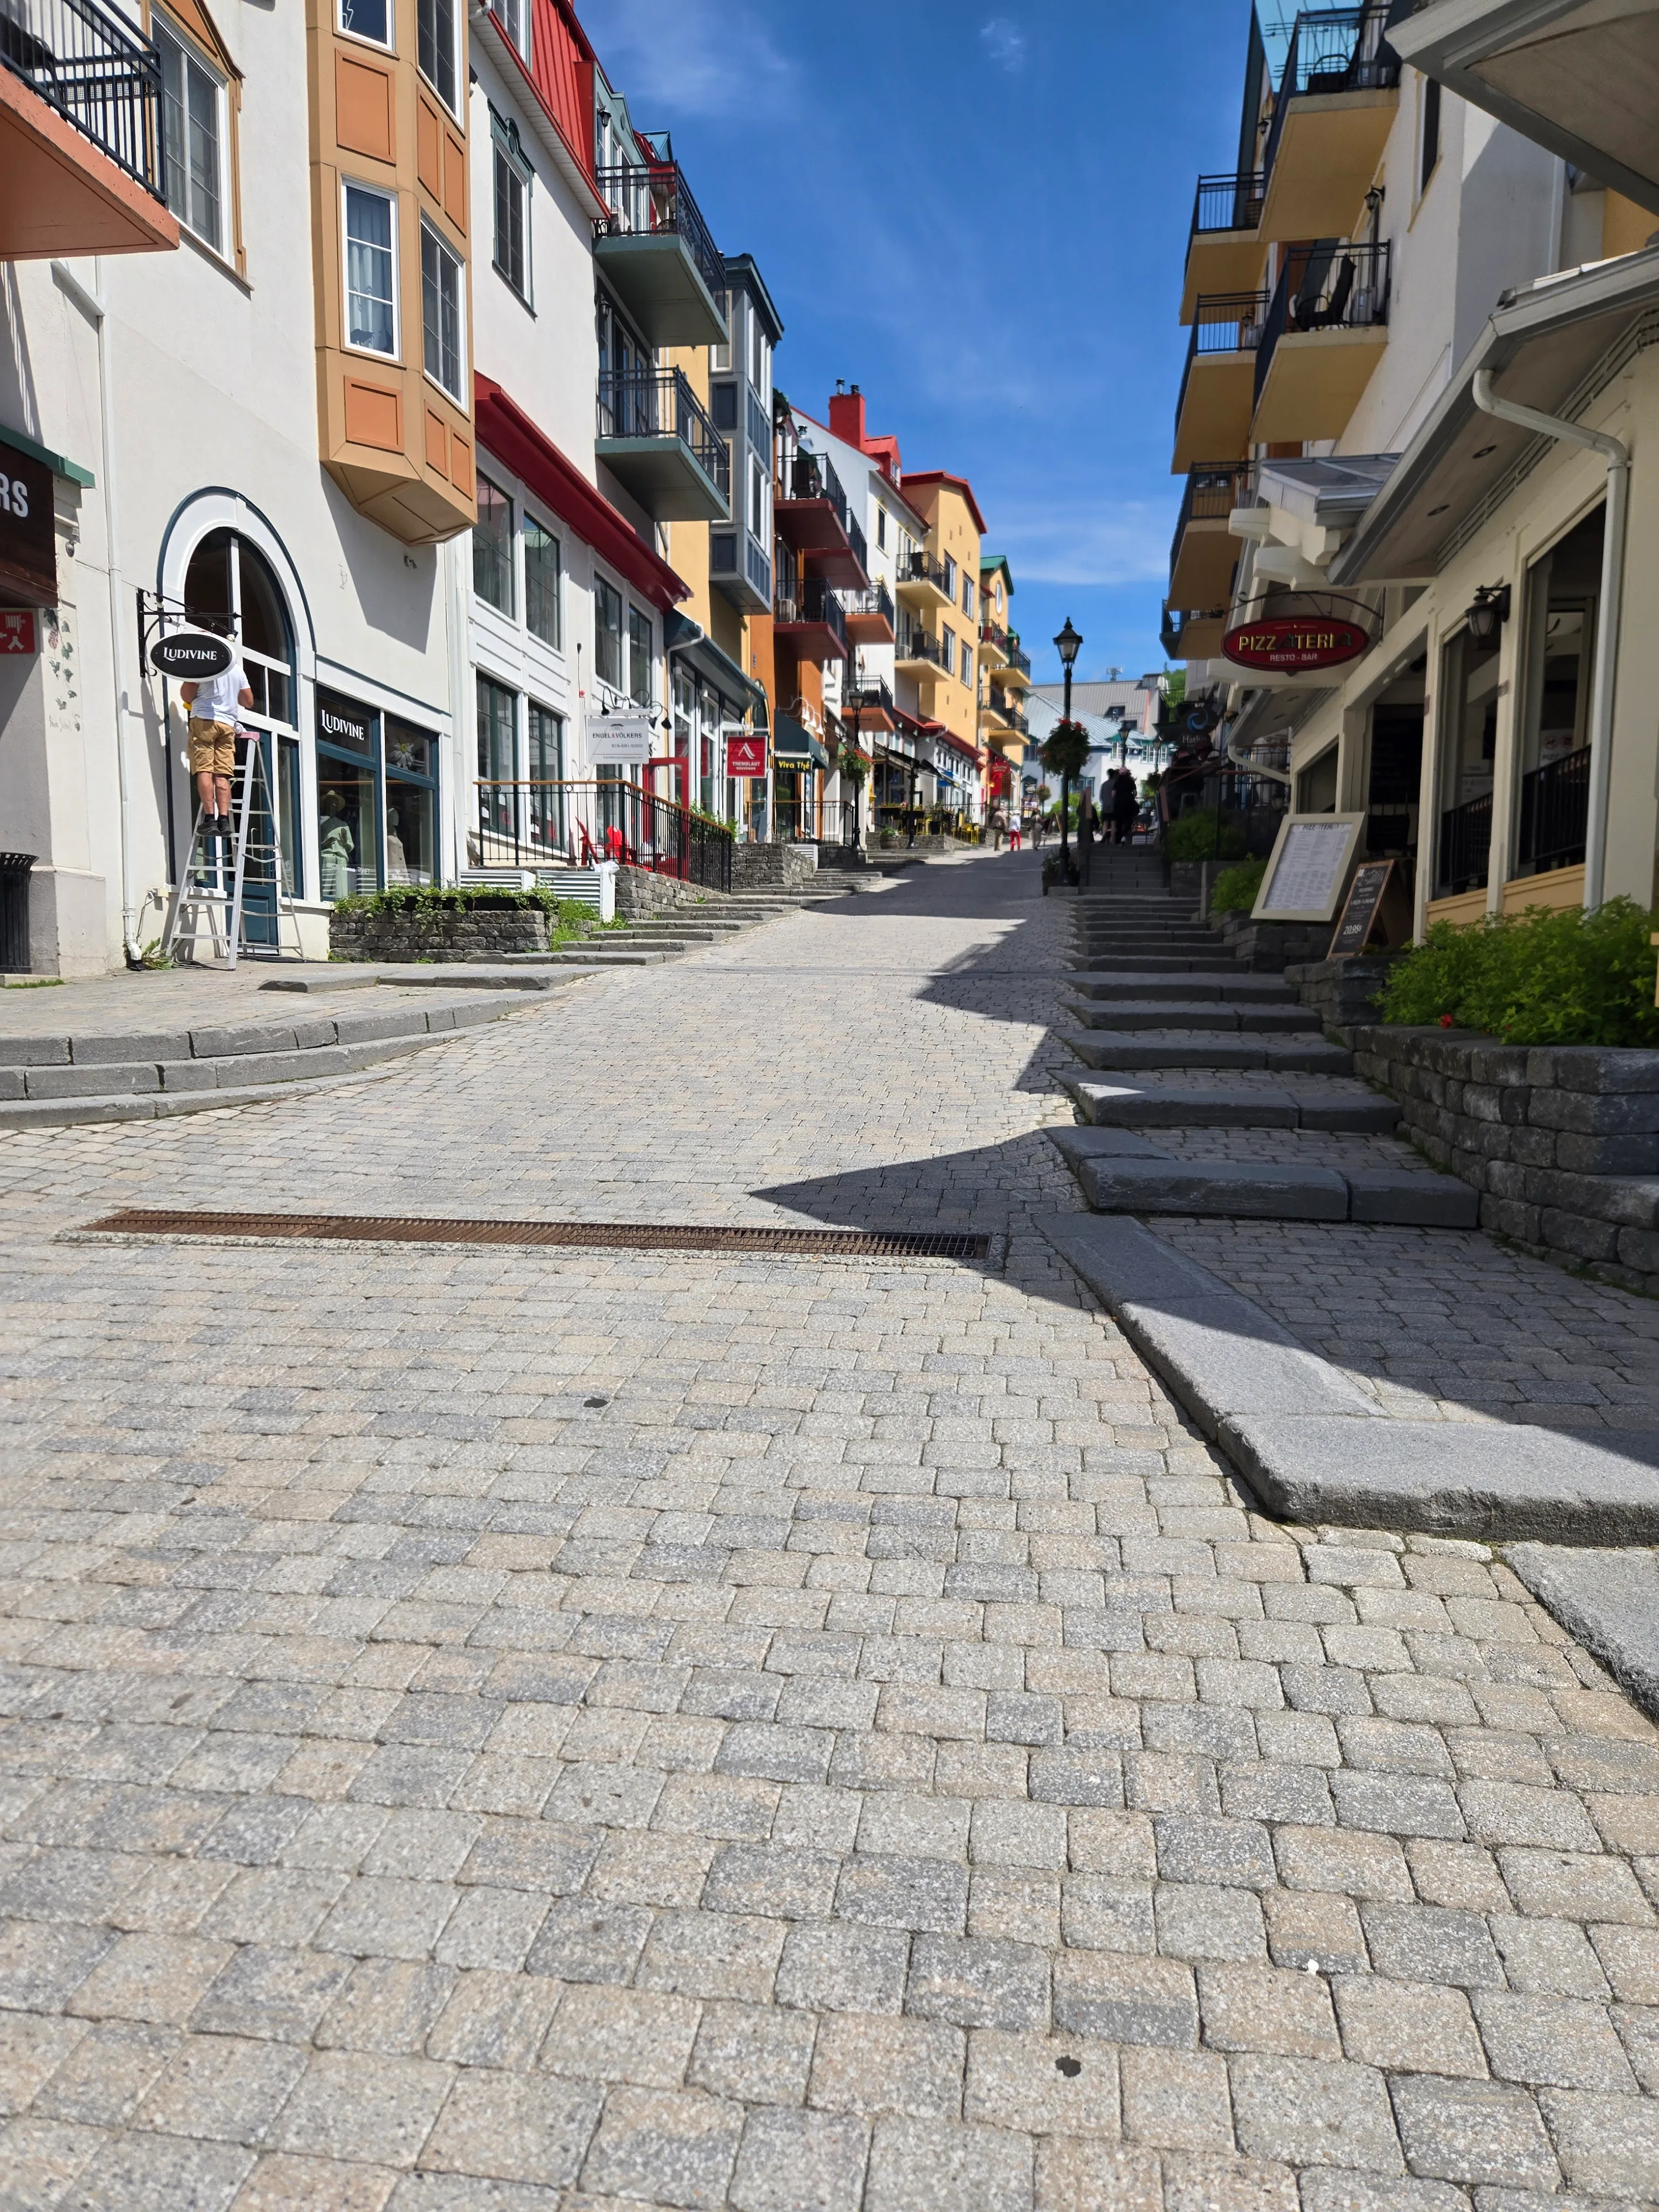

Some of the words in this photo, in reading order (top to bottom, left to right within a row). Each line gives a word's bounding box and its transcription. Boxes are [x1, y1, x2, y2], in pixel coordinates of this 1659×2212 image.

[1239, 632, 1352, 651] PIZZATERIA
[163, 647, 217, 661] LUDIVINE
[321, 709, 364, 740] LUDIVINE
[797, 761, 810, 770] Thé
